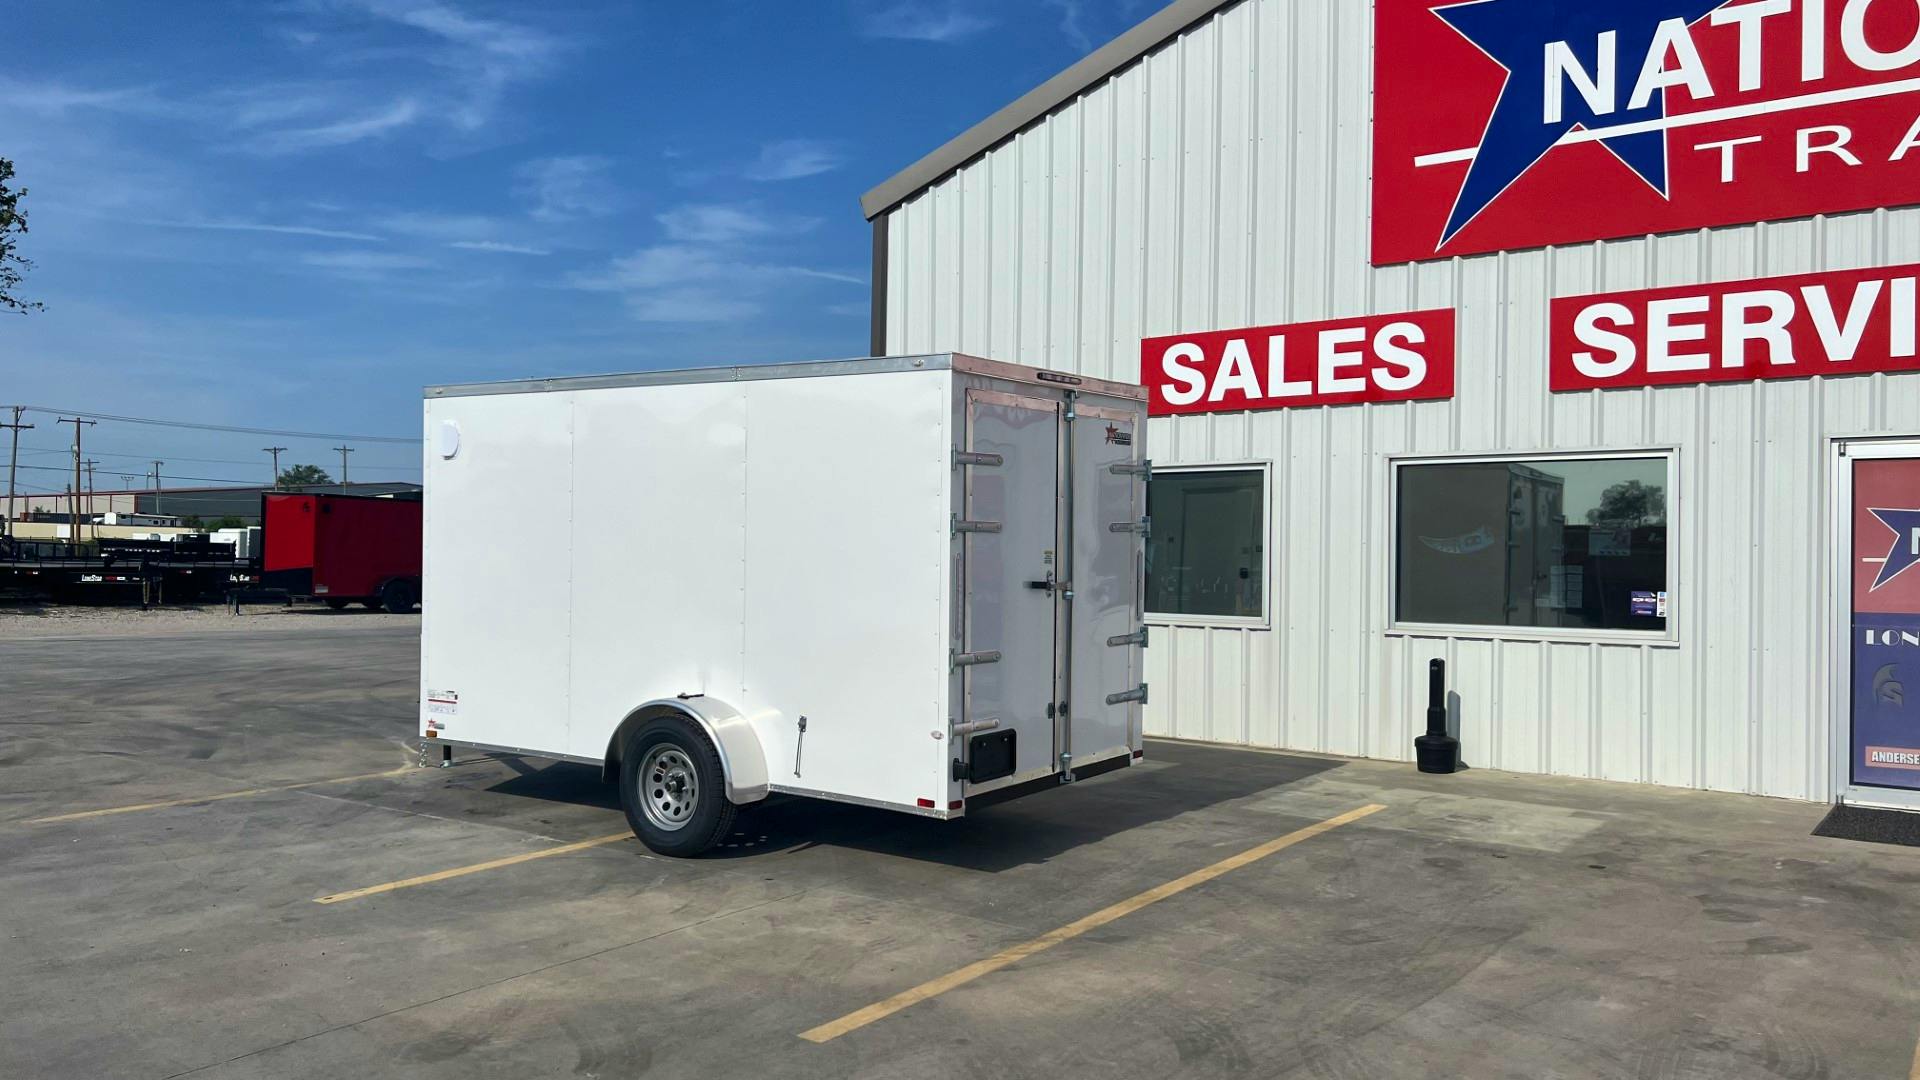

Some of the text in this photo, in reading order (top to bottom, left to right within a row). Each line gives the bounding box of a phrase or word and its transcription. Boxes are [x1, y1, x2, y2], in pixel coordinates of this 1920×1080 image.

[1543, 0, 1920, 124] NATIO
[1160, 321, 1428, 406] SALES
[1571, 276, 1917, 378] SERVI
[1866, 629, 1920, 647] LON
[1871, 751, 1920, 765] ANDERSE
